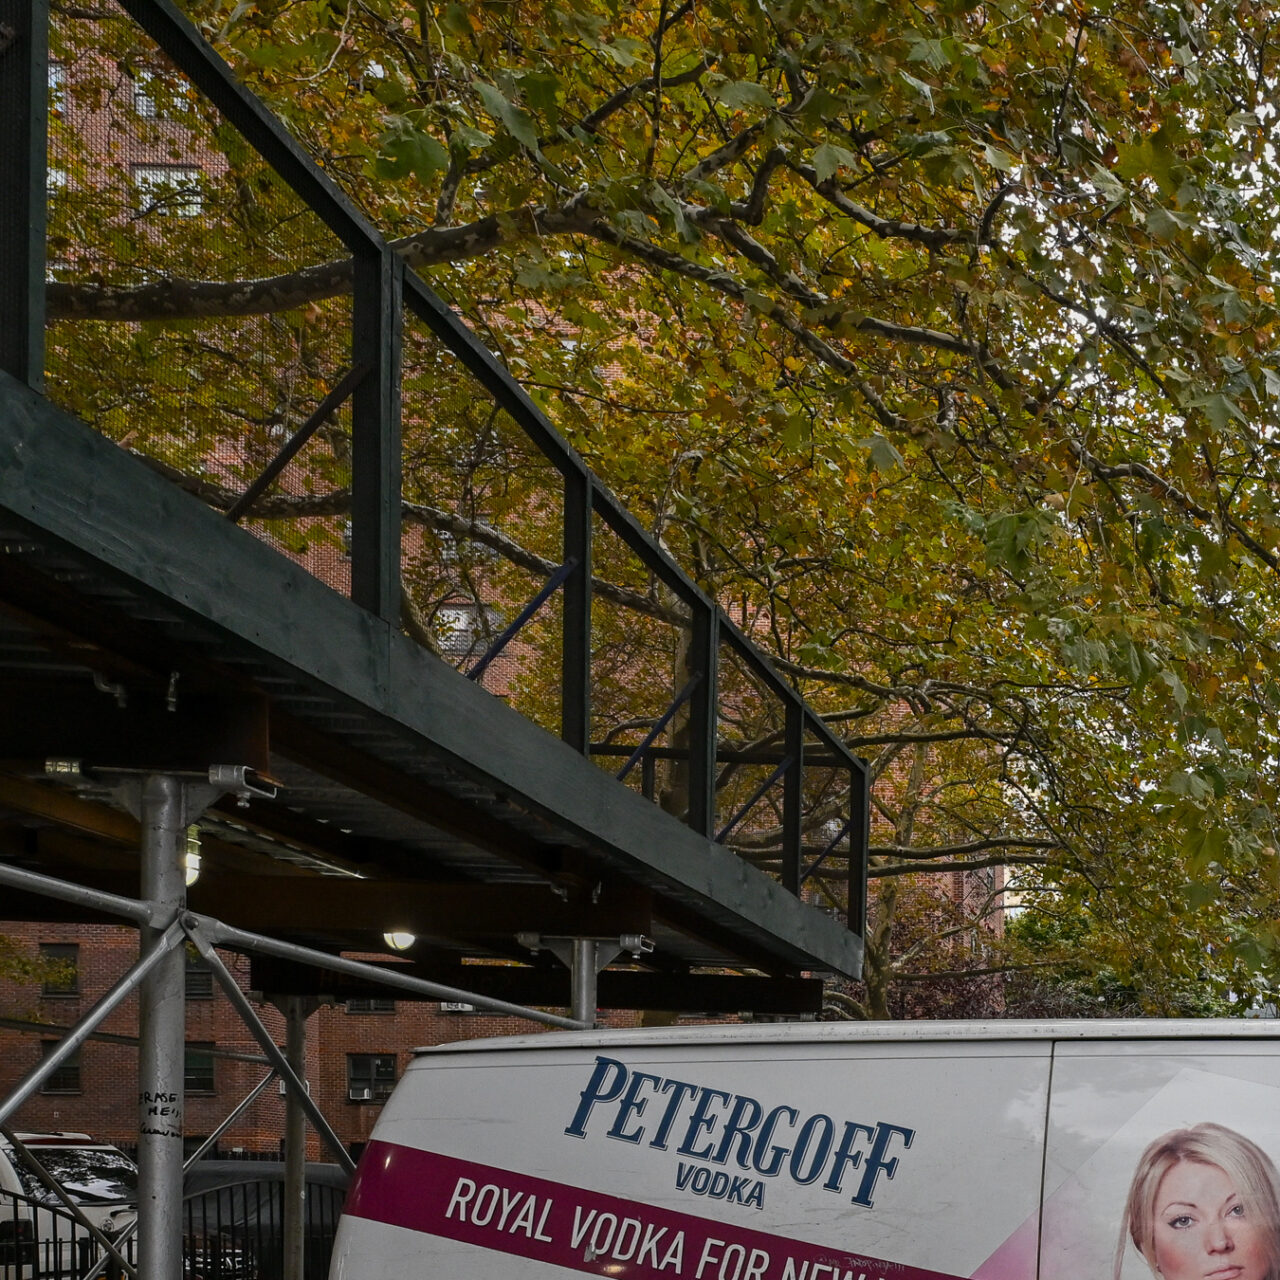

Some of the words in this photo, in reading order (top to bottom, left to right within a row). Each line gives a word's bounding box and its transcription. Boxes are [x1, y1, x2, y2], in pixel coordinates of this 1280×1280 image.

[563, 1054, 916, 1209] PETERGOFF
[444, 1176, 554, 1244] ROYAL
[570, 1205, 686, 1275] VODKA
[675, 1161, 765, 1210] VODKA
